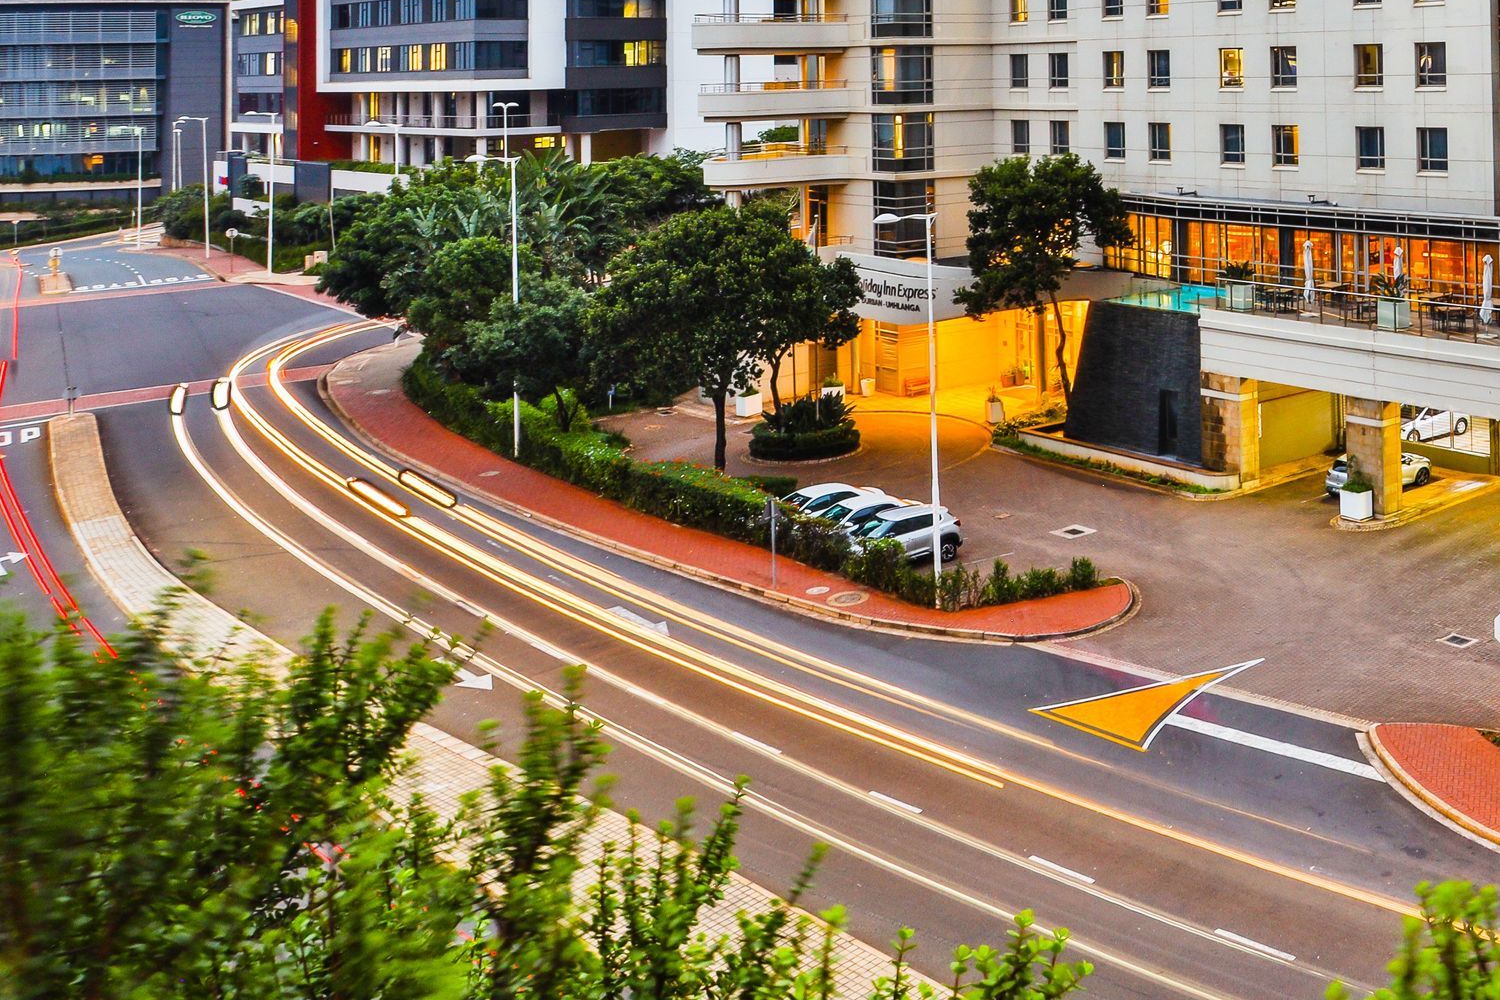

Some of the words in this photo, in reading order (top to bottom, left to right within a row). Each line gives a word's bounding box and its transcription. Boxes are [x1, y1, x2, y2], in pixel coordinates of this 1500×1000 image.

[858, 278, 882, 298] oliday
[883, 280, 896, 296] Inn
[897, 284, 936, 302] Express
[886, 301, 920, 312] UMHLANGA
